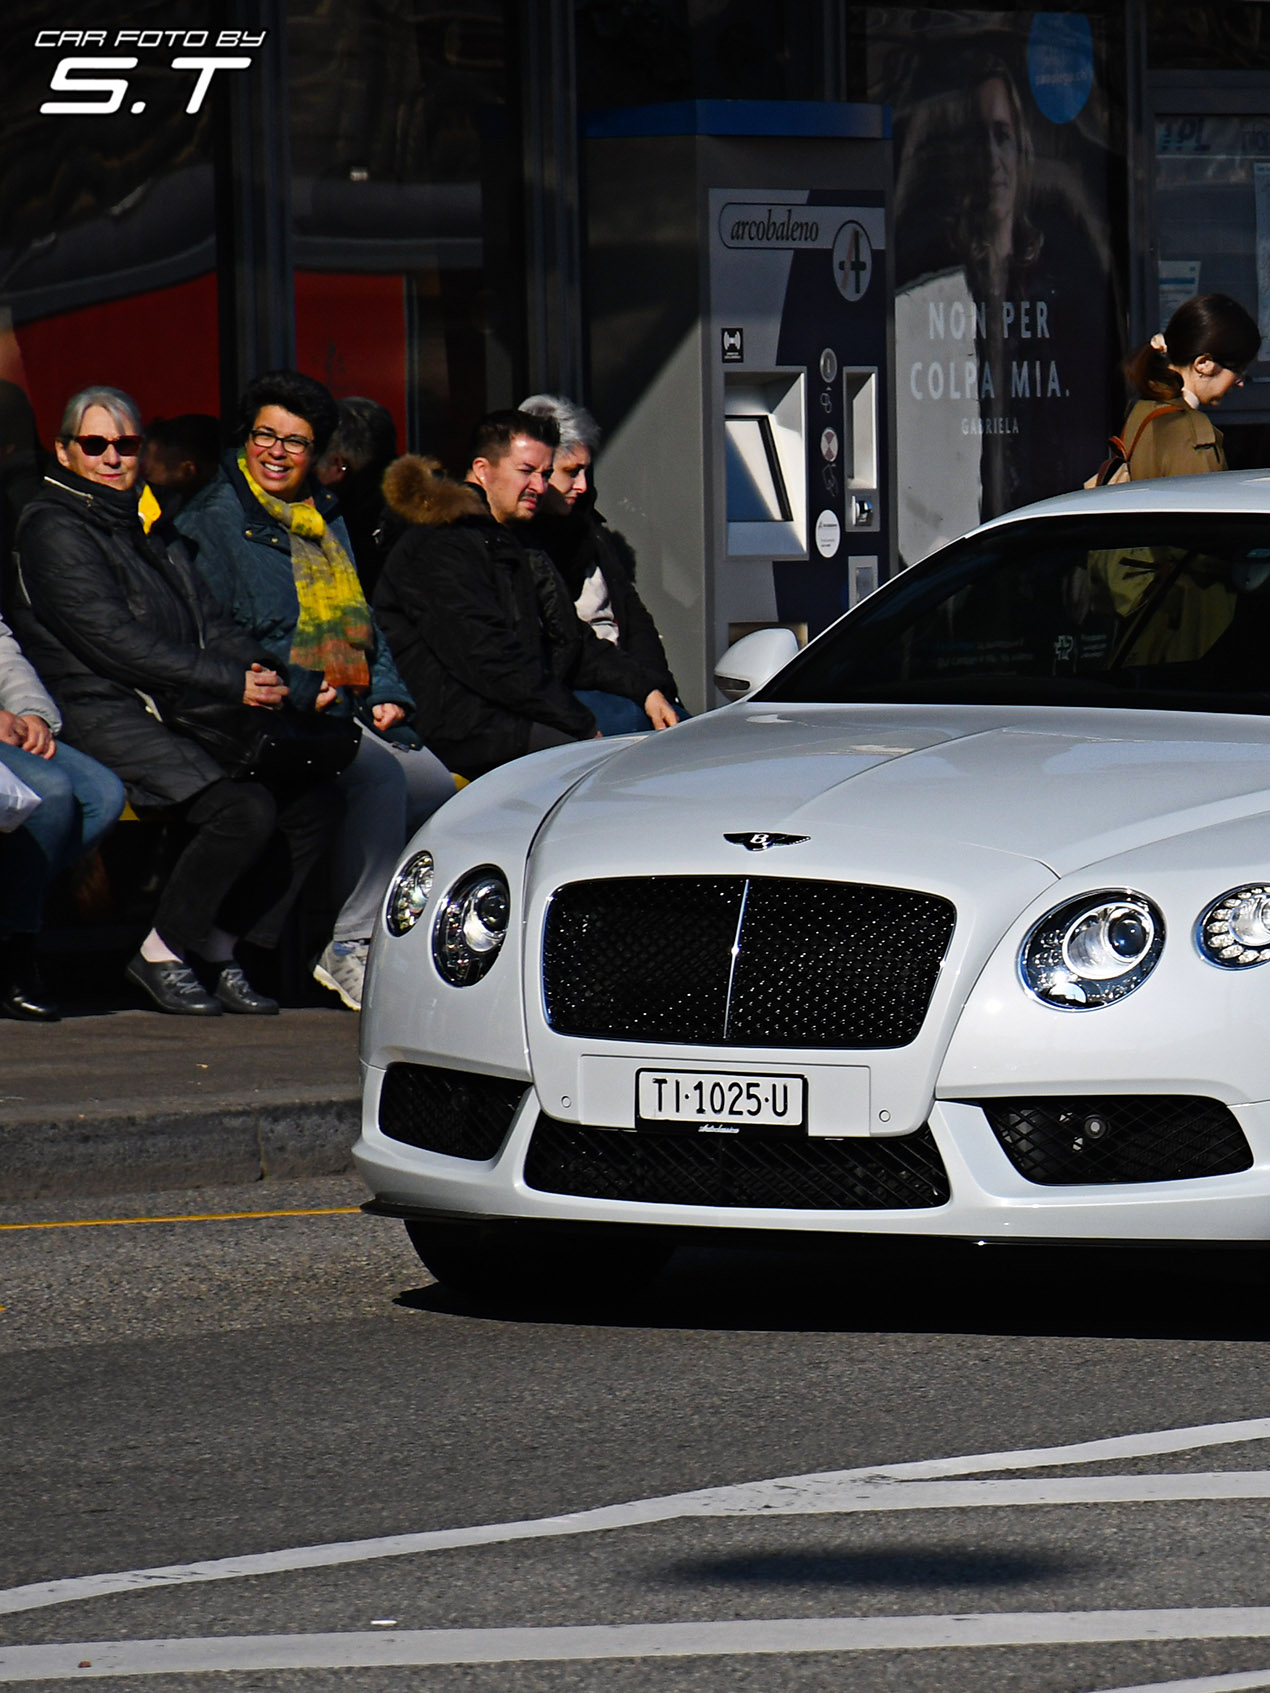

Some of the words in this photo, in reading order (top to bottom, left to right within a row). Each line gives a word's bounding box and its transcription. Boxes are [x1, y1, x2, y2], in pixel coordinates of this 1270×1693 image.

[730, 208, 820, 242] arcobaleno
[929, 301, 988, 340] NON
[1001, 300, 1051, 340] PER
[910, 360, 996, 401] COLPA
[1010, 359, 1071, 399] MIA.
[960, 416, 1020, 436] GABRIELA
